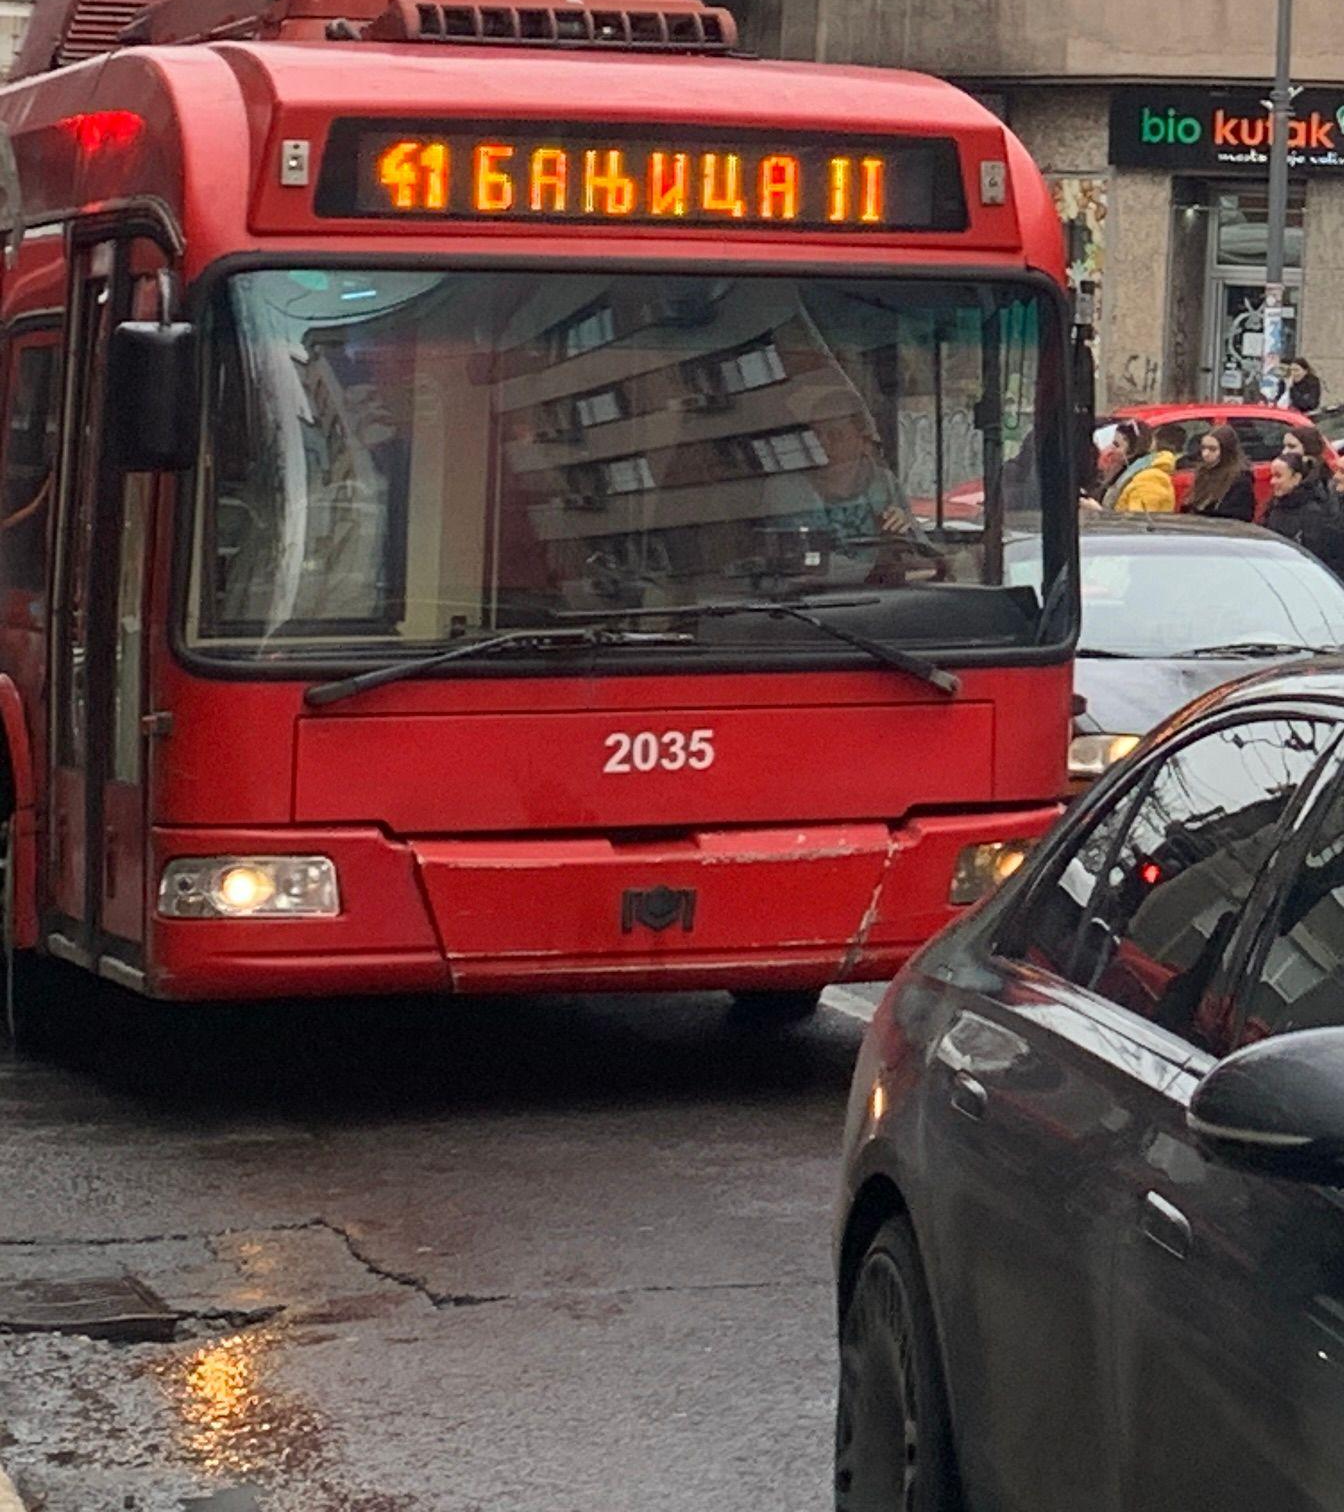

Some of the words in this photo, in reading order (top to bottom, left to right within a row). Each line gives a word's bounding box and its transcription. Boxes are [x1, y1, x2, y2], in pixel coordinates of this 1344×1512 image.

[1141, 107, 1202, 144] bio
[377, 141, 448, 210] 41
[472, 143, 800, 220] БАЊИЦА
[602, 729, 716, 774] 2035
